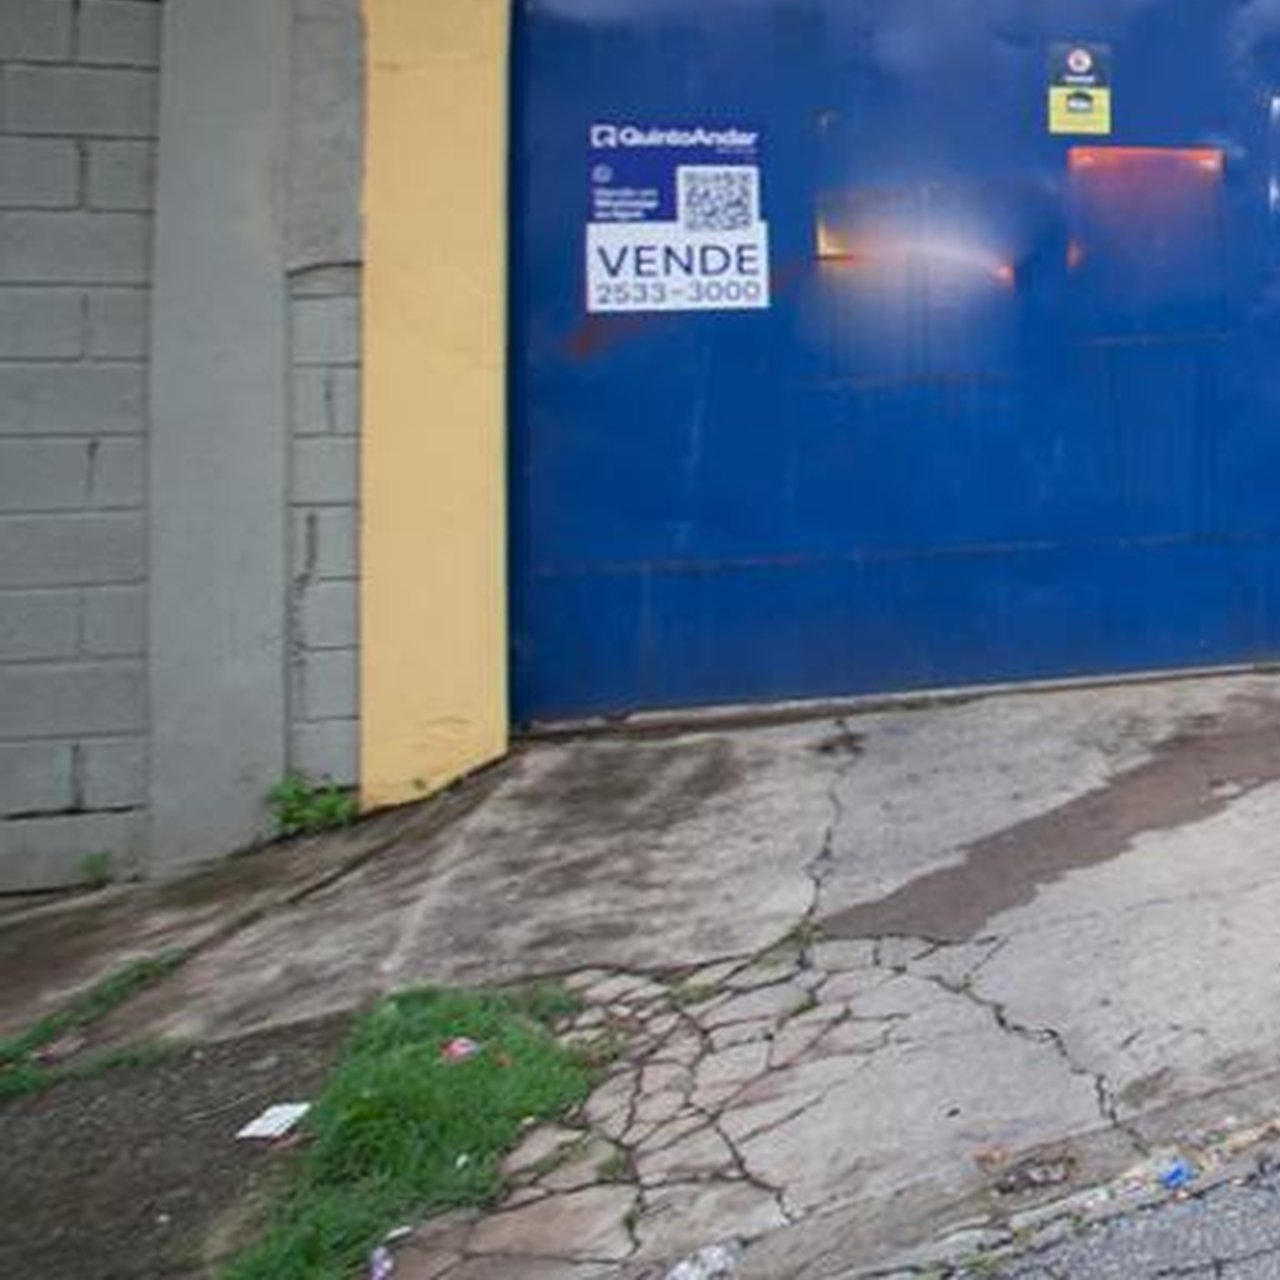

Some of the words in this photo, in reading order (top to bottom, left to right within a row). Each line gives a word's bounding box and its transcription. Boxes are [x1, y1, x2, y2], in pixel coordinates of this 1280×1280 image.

[618, 125, 758, 146] QuintoAndar
[597, 243, 760, 277] VENDE
[596, 279, 761, 305] 2533-3000
